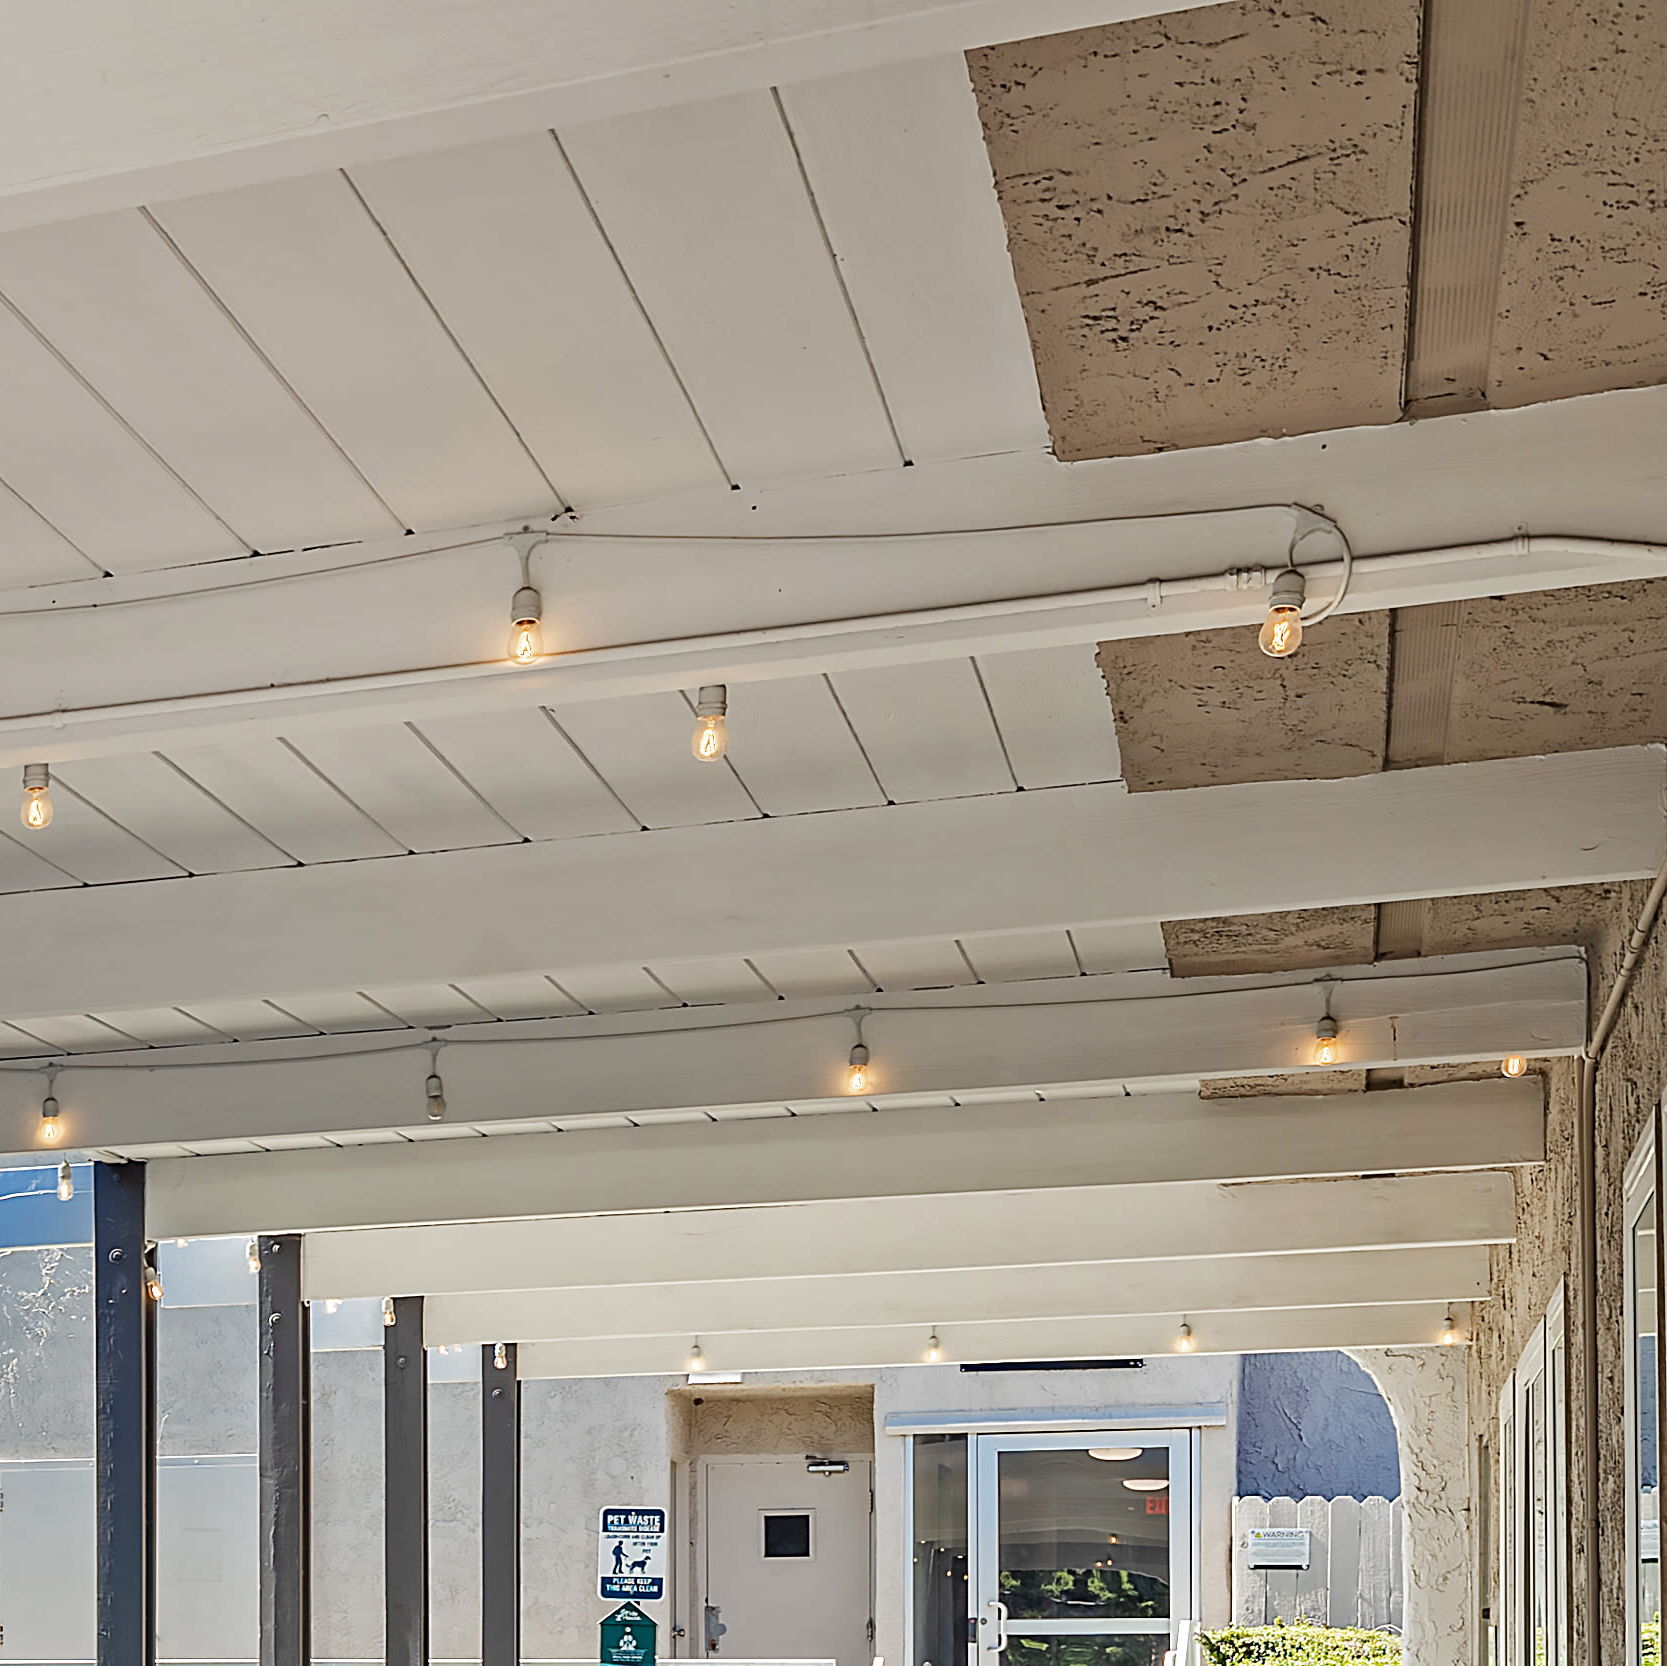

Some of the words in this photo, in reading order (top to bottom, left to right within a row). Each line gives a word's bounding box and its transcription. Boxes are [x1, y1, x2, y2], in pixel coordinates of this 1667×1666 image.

[608, 1514, 626, 1525] PET
[628, 1514, 661, 1526] WASTE
[1263, 1530, 1305, 1538] WARNING
[621, 1584, 637, 1592] AREA
